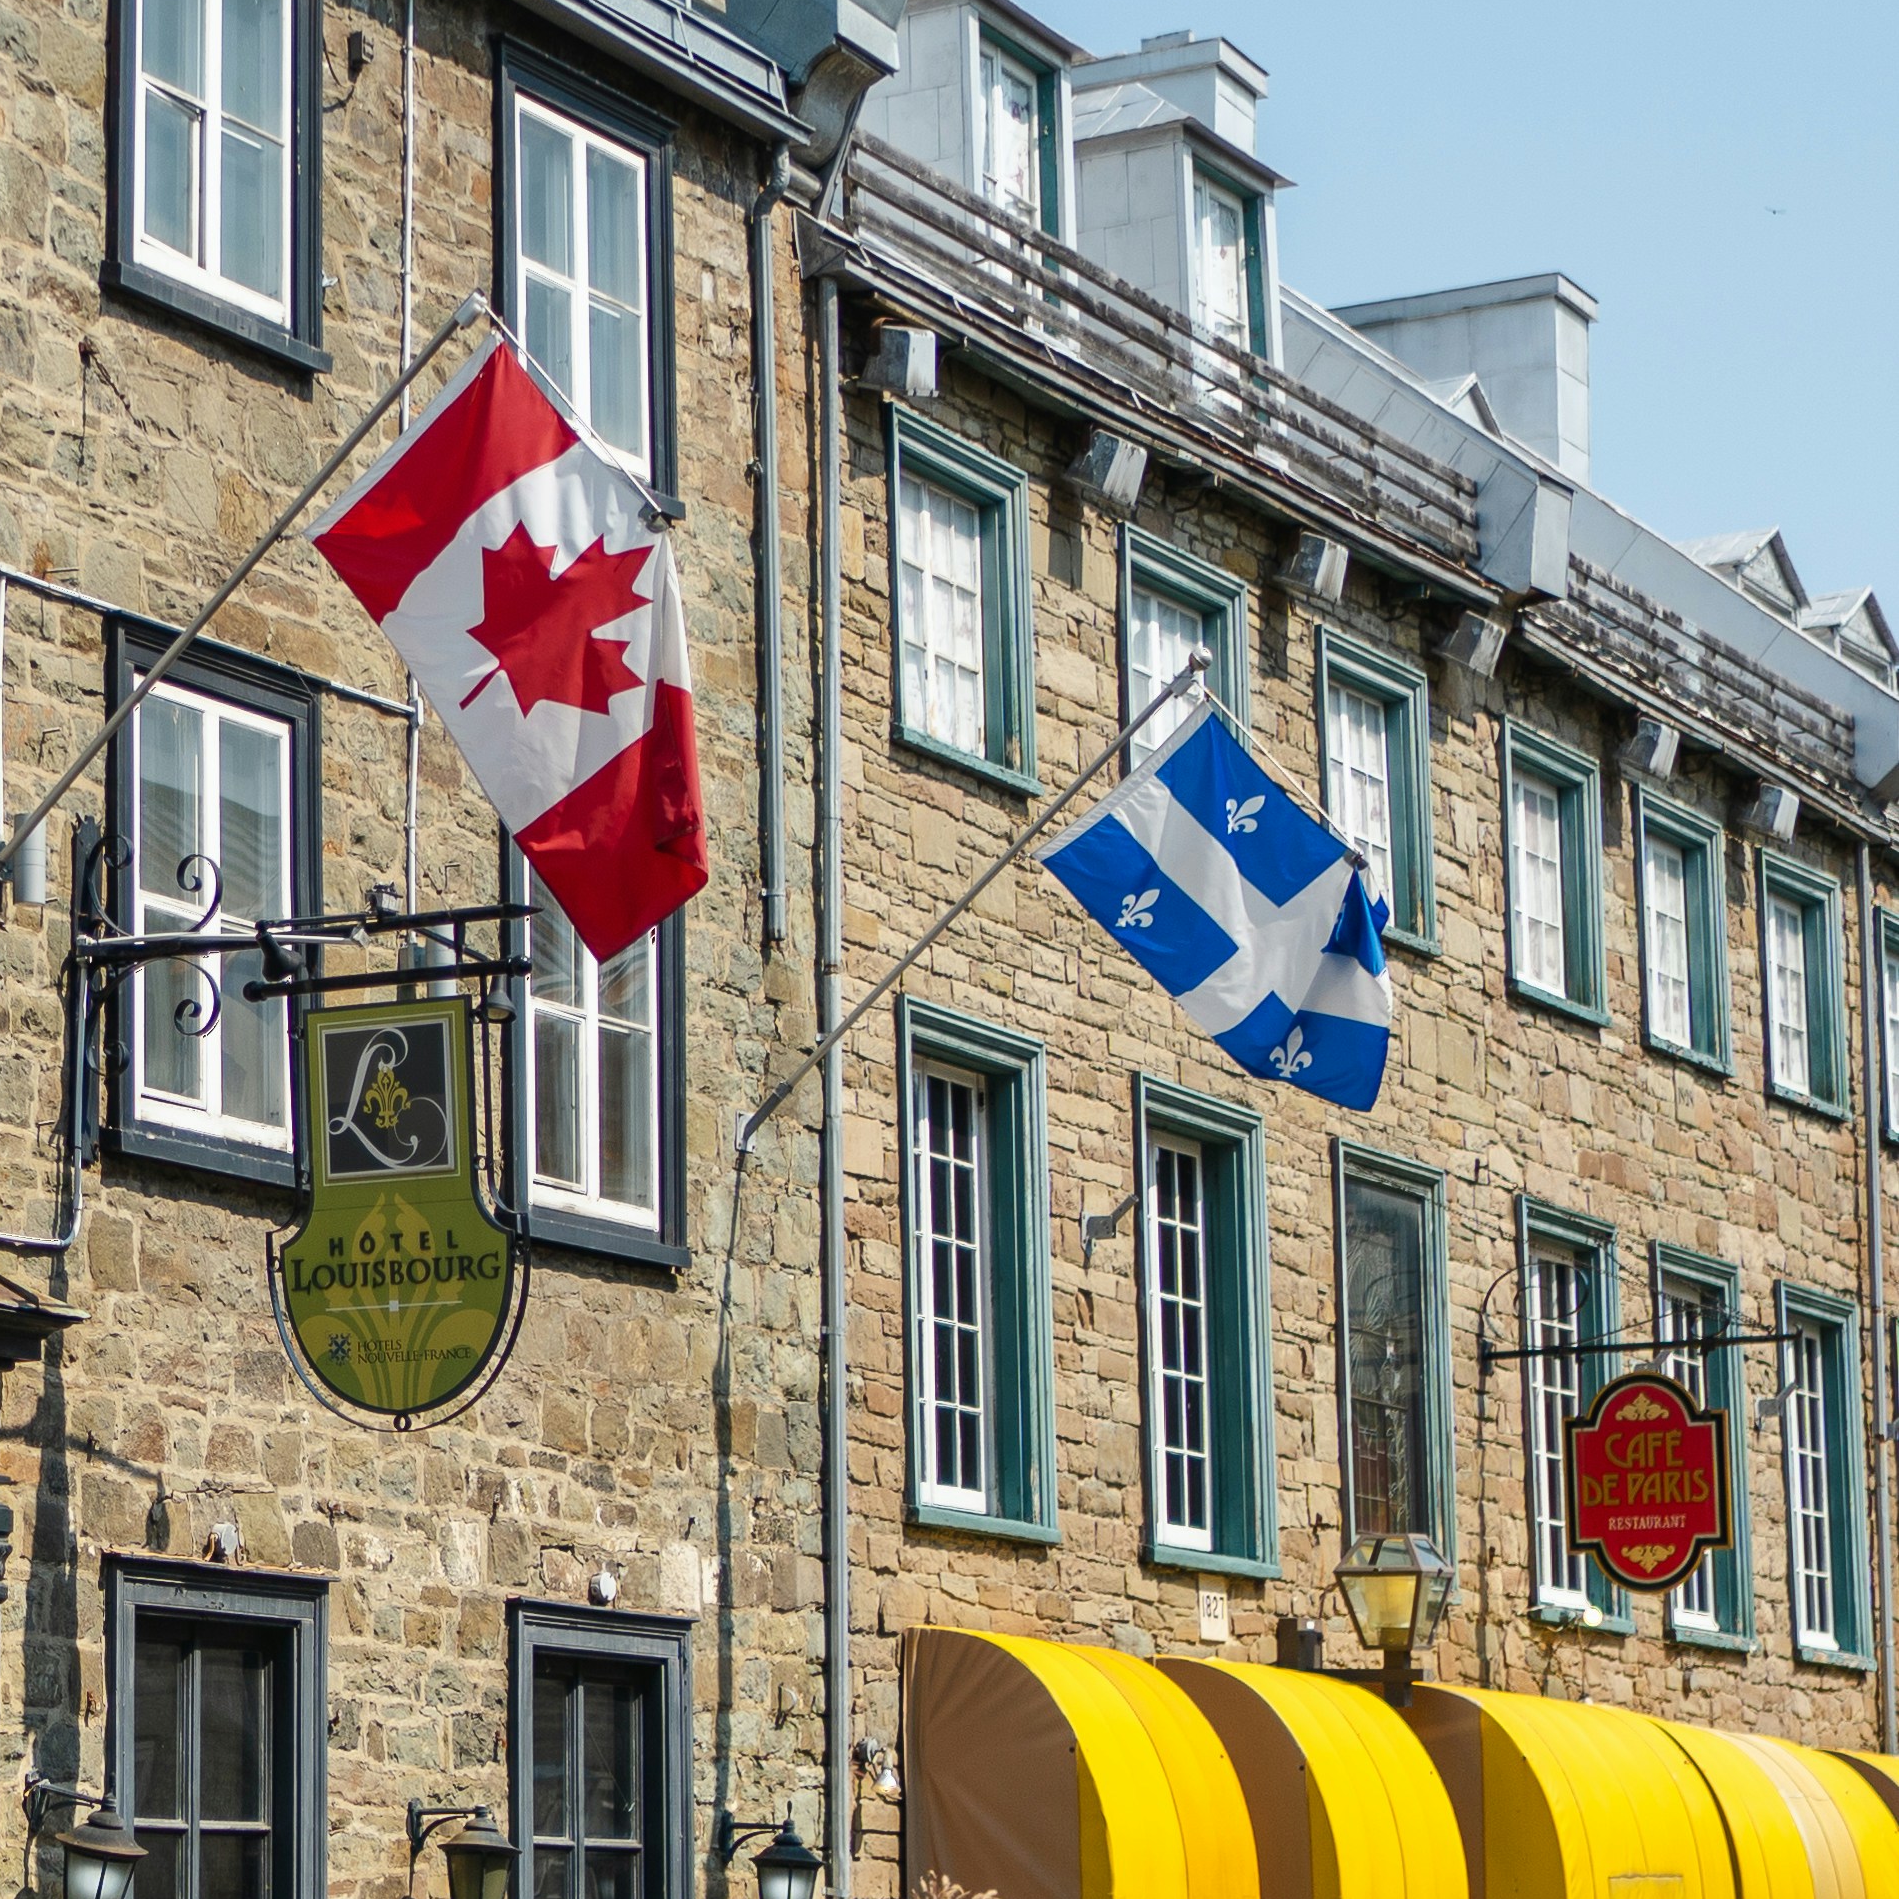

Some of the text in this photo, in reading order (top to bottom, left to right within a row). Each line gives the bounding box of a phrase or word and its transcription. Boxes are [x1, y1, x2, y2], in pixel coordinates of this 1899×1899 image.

[329, 1230, 459, 1257] HÔTEL
[291, 1251, 502, 1296] LOUISBOURG
[357, 1346, 472, 1365] NOUVELLE-FRANCE
[1581, 1469, 1710, 1508] DE PARIS
[1608, 1513, 1687, 1531] RESTAURANT
[1202, 1594, 1224, 1620] 1827
